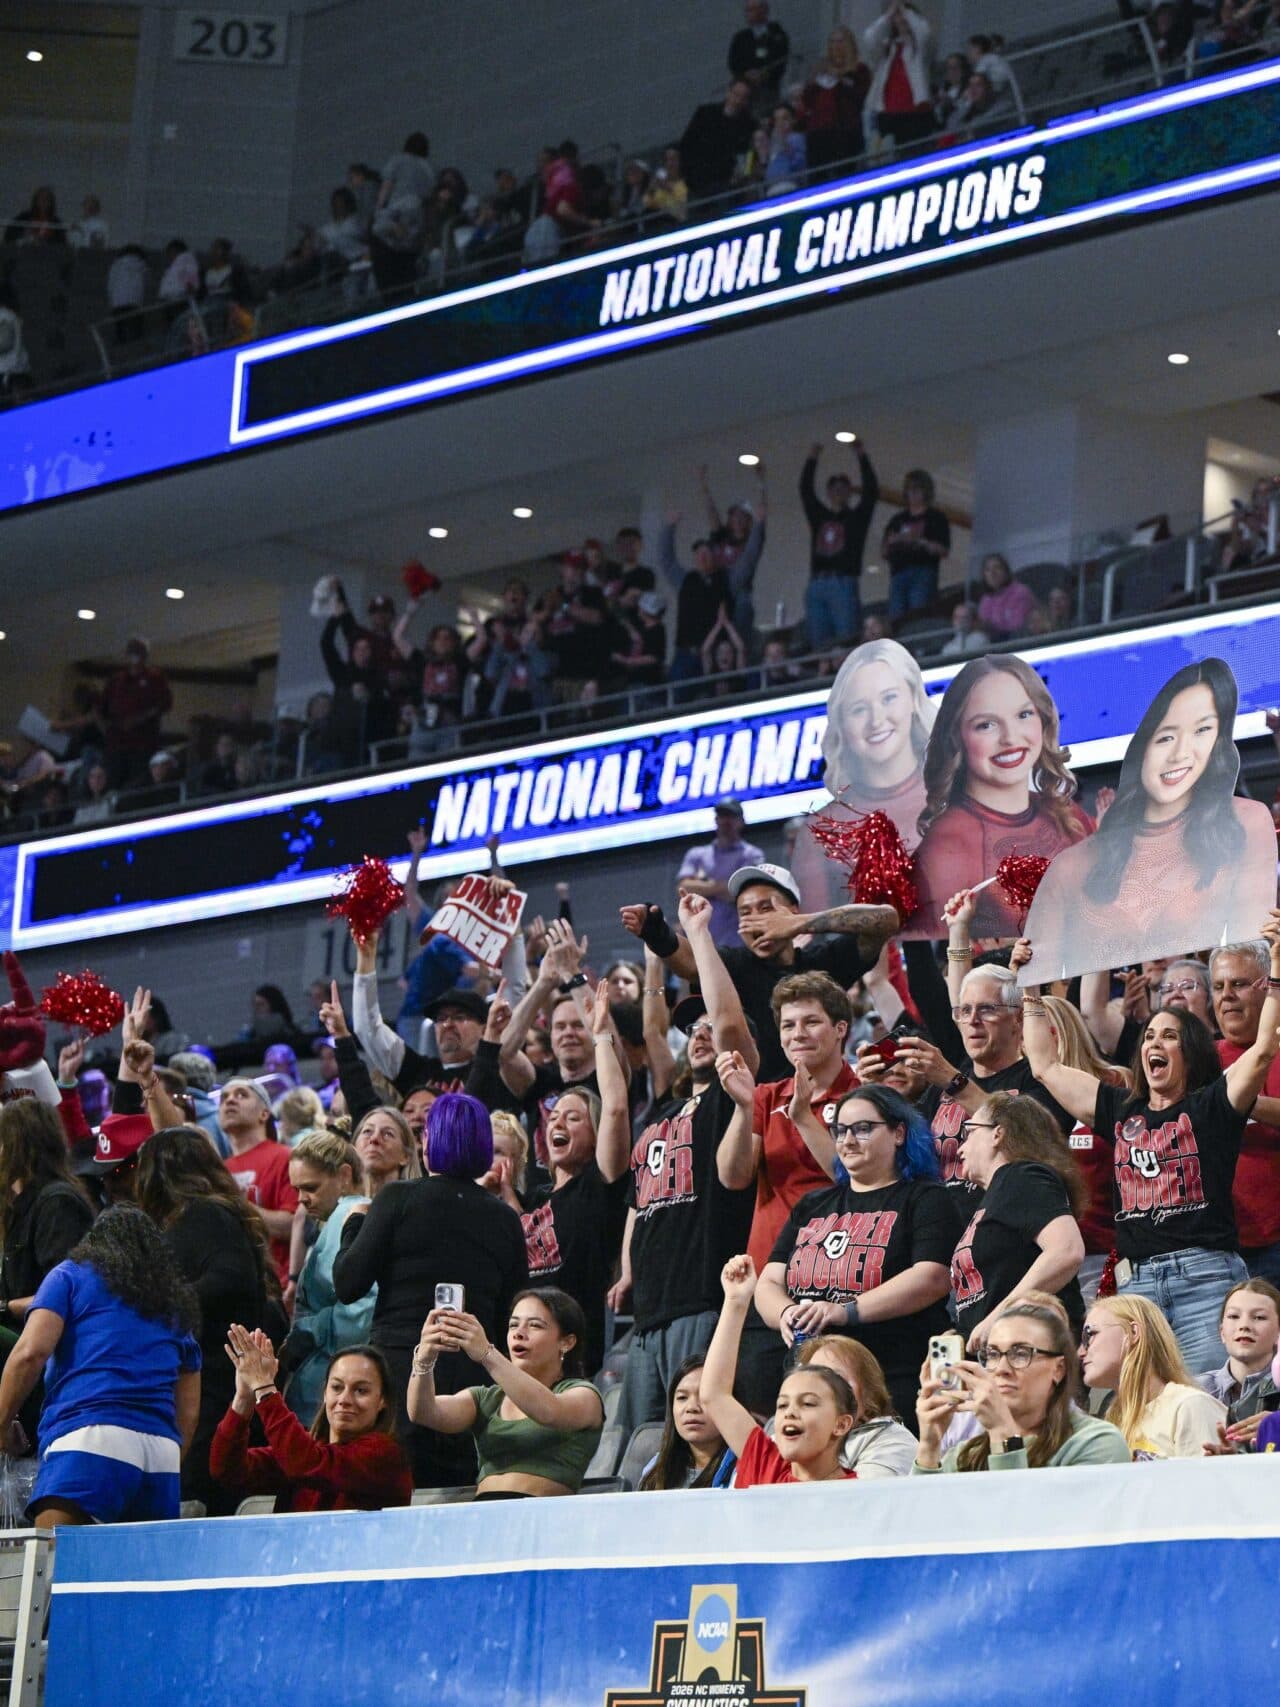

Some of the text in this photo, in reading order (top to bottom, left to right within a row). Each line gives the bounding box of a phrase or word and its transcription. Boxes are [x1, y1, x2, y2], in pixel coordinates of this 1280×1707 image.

[189, 18, 275, 58] 203
[599, 155, 1047, 326] NATIONAL CHAMPIONS
[431, 749, 643, 845] NATIONAL
[697, 1622, 729, 1638] NCAA
[671, 1684, 745, 1695] 2026 NC WOMEN'S
